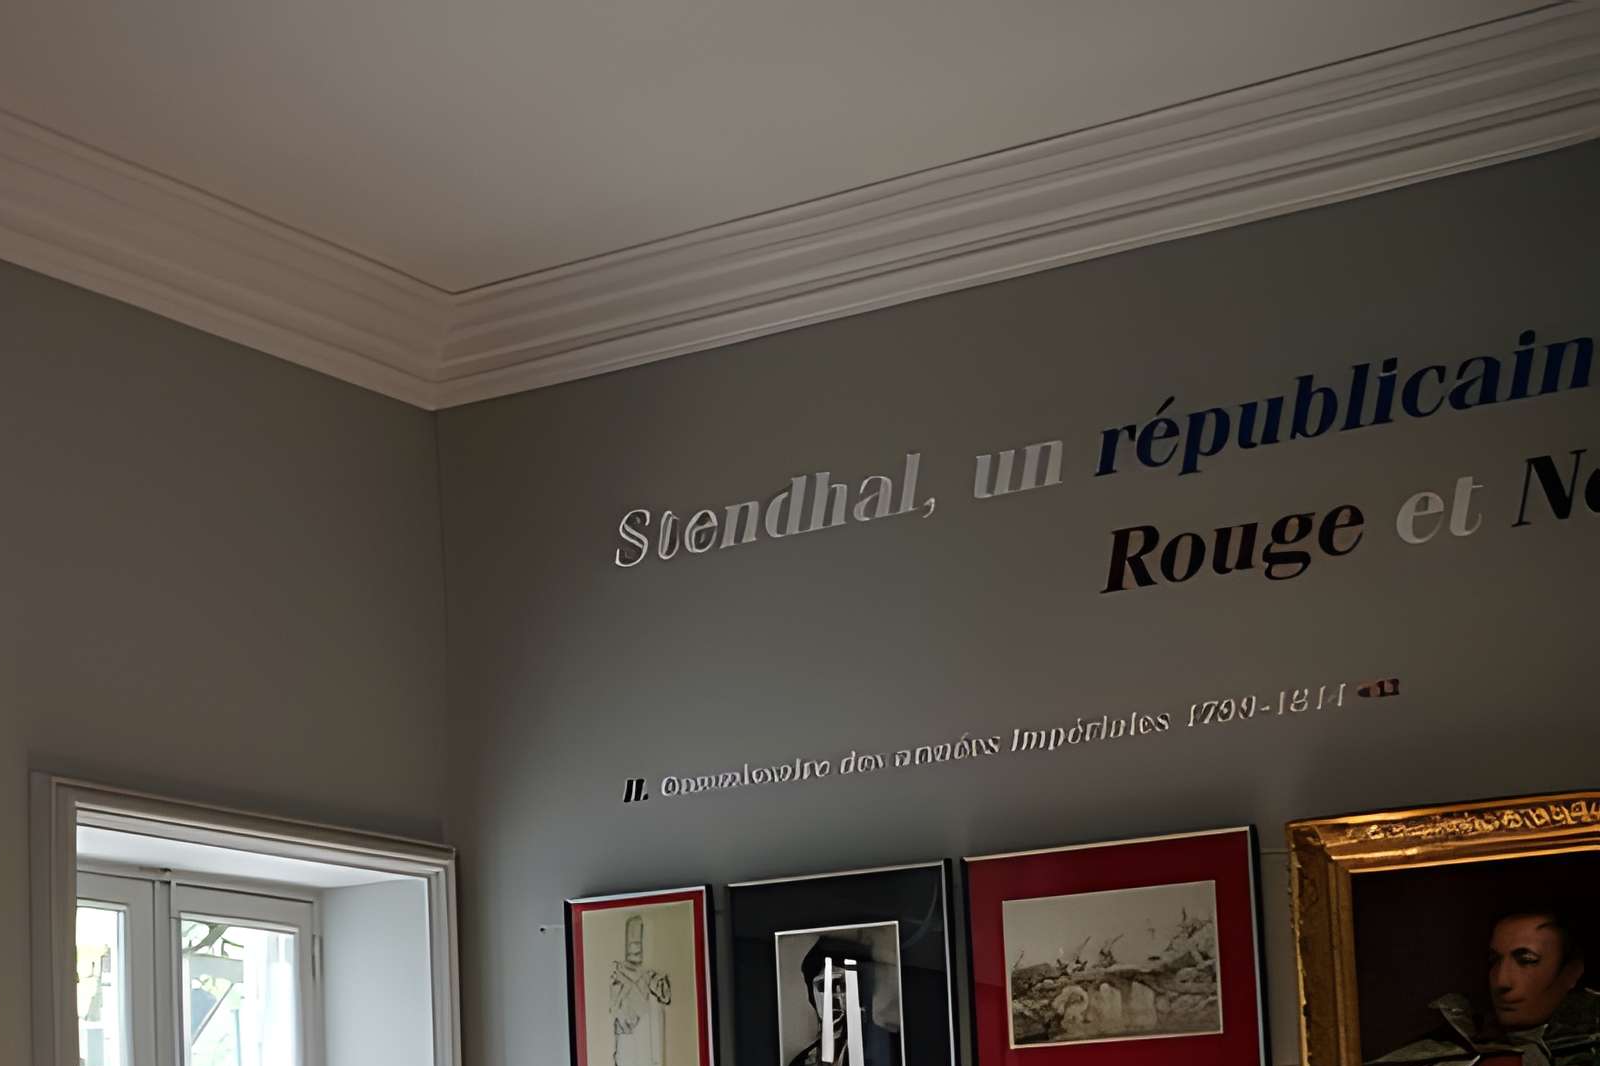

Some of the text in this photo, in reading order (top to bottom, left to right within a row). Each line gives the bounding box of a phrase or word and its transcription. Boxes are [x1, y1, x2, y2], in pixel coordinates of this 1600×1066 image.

[613, 452, 937, 567] Stendhal,
[973, 438, 1065, 499] un
[1099, 502, 1366, 595] Rouge
[1395, 474, 1484, 545] et
